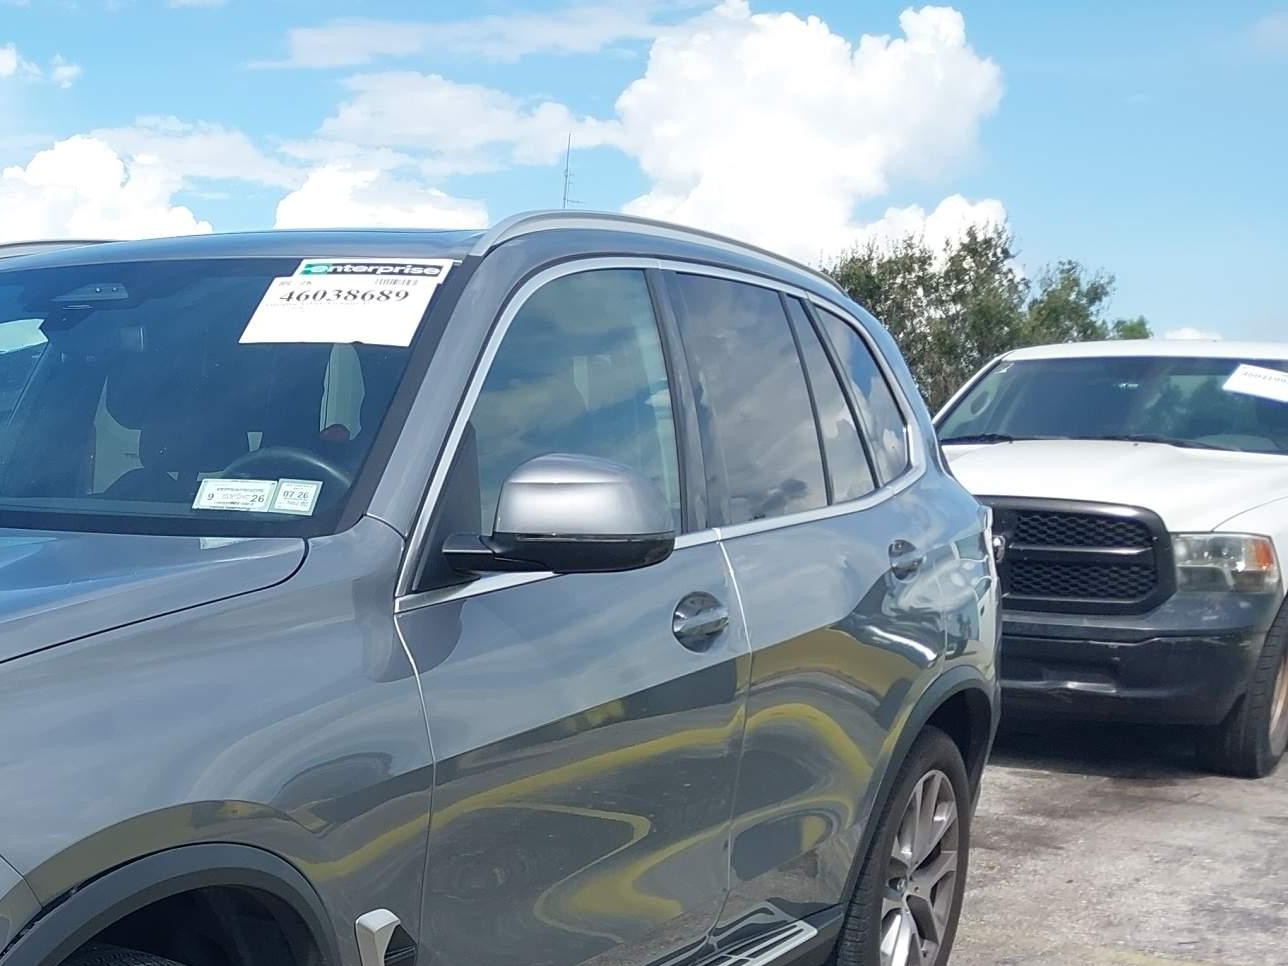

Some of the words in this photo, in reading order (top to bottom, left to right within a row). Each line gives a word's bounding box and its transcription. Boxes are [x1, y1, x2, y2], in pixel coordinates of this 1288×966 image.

[311, 263, 442, 276] enterprise
[279, 289, 409, 302] 46038689
[250, 494, 265, 503] 26
